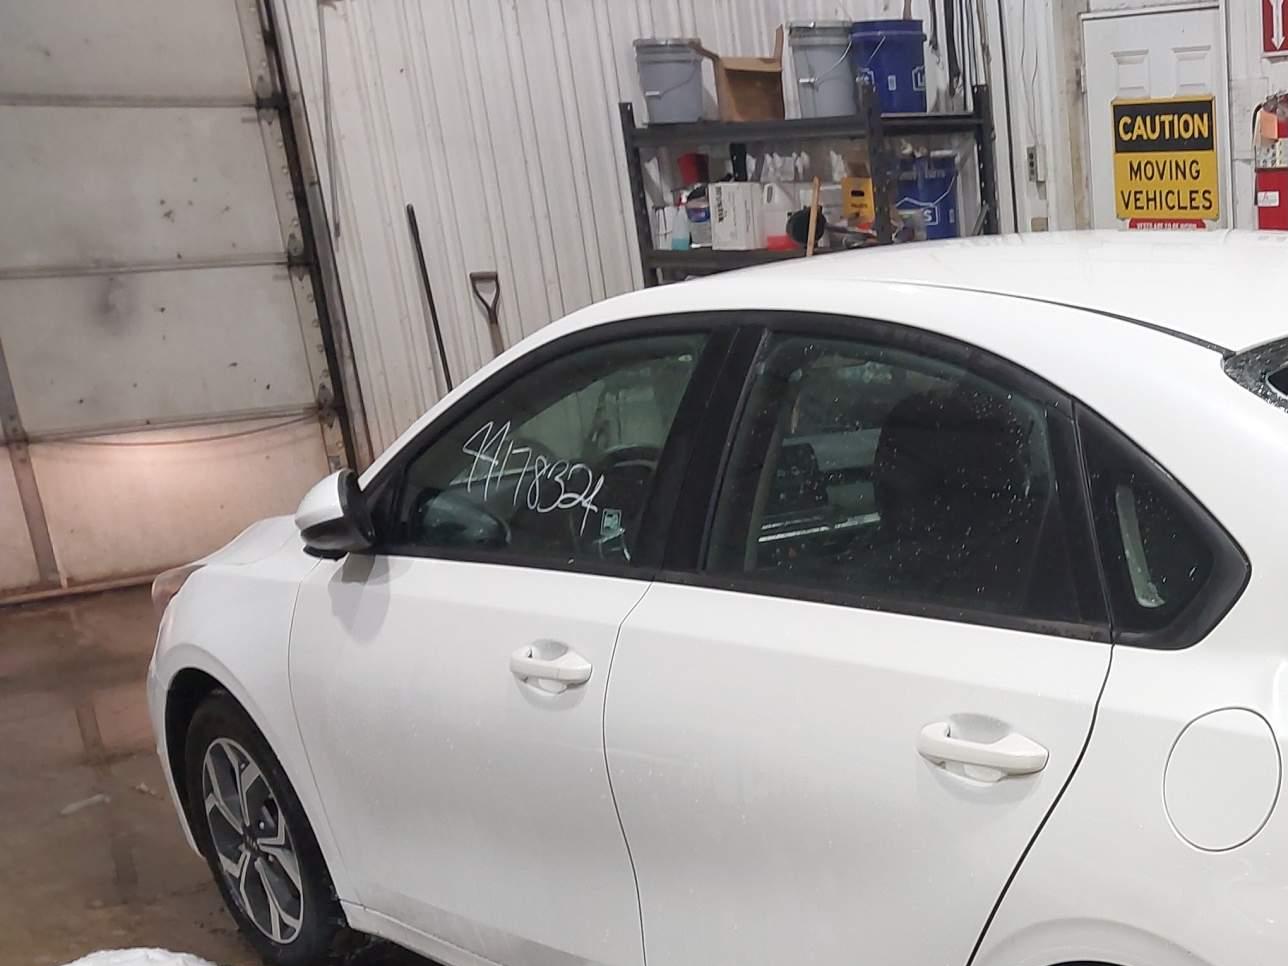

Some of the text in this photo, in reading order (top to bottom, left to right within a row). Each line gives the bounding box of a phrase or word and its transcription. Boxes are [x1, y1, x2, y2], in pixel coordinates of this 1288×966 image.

[1119, 113, 1209, 141] CAUTION
[1129, 160, 1201, 181] MOVING
[1121, 191, 1213, 211] VEHICLES
[462, 420, 605, 537] 44178324
